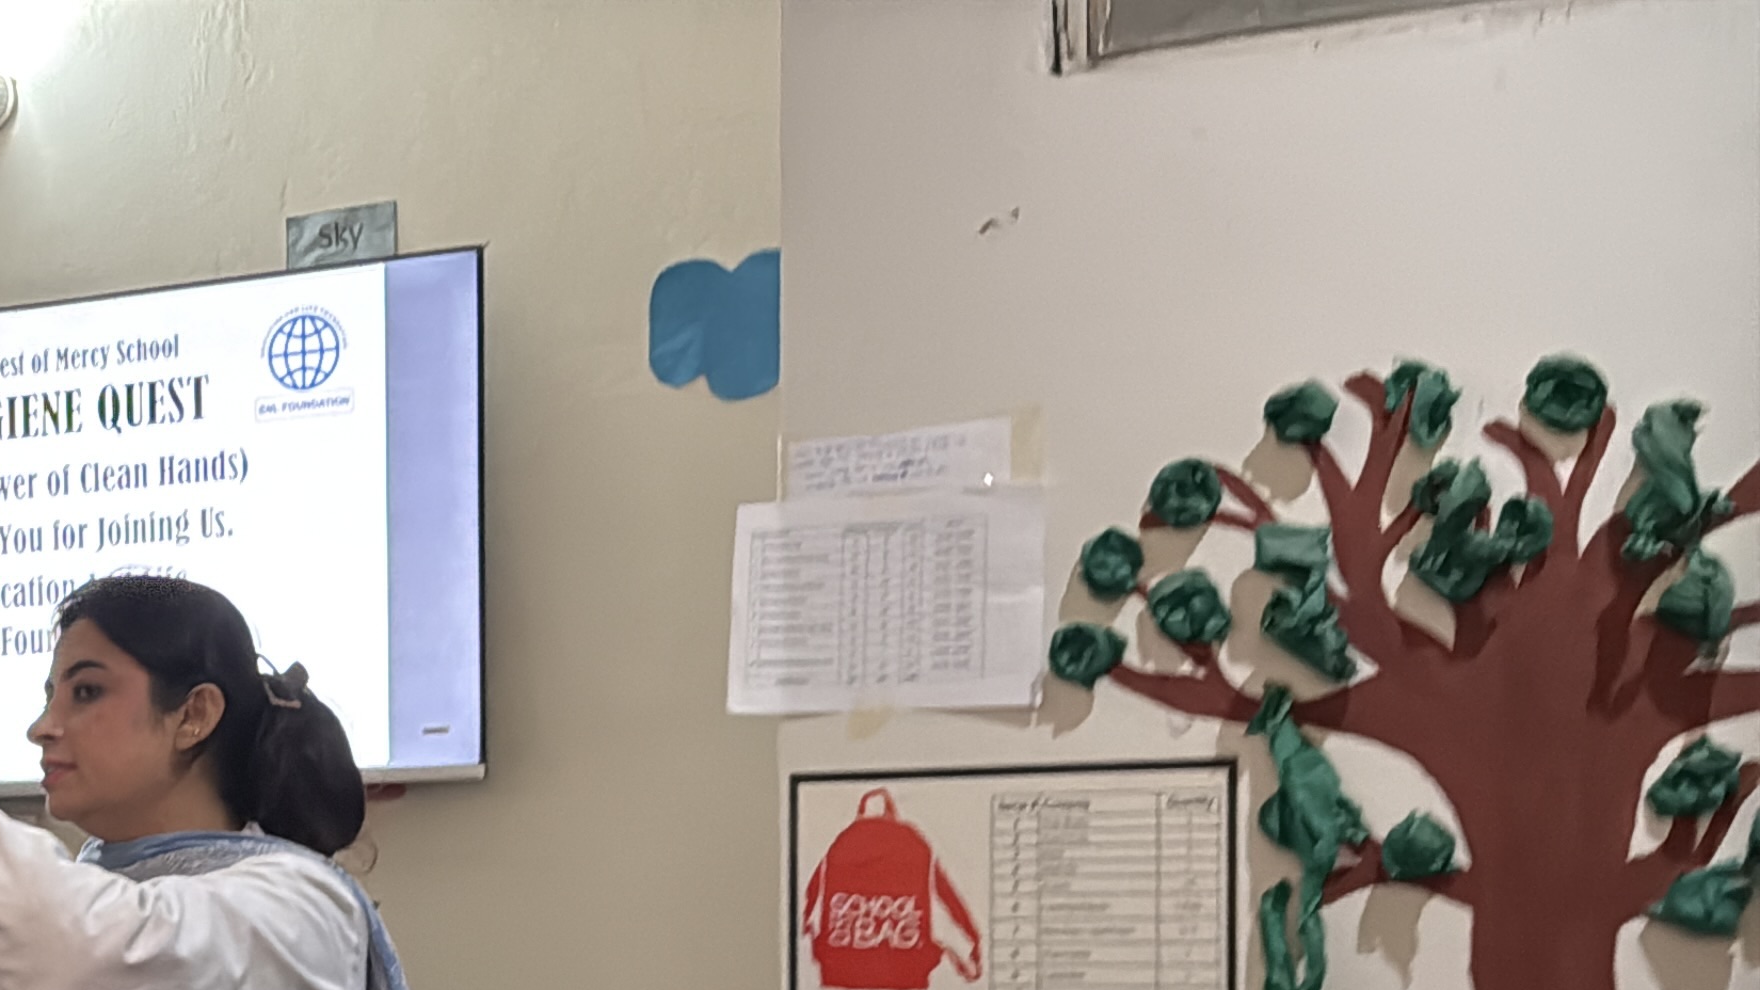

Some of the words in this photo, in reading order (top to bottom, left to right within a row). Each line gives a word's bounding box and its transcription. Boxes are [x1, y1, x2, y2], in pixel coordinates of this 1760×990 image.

[32, 348, 49, 374] of
[55, 343, 110, 371] Mercy
[117, 333, 180, 365] School
[97, 374, 210, 434] QUEST
[47, 464, 71, 497] of
[80, 461, 149, 494] Clean
[158, 447, 249, 488] Hands)
[52, 519, 88, 552] for
[96, 508, 190, 554] Joining
[200, 506, 234, 539] Us.
[853, 918, 921, 949] BAG
